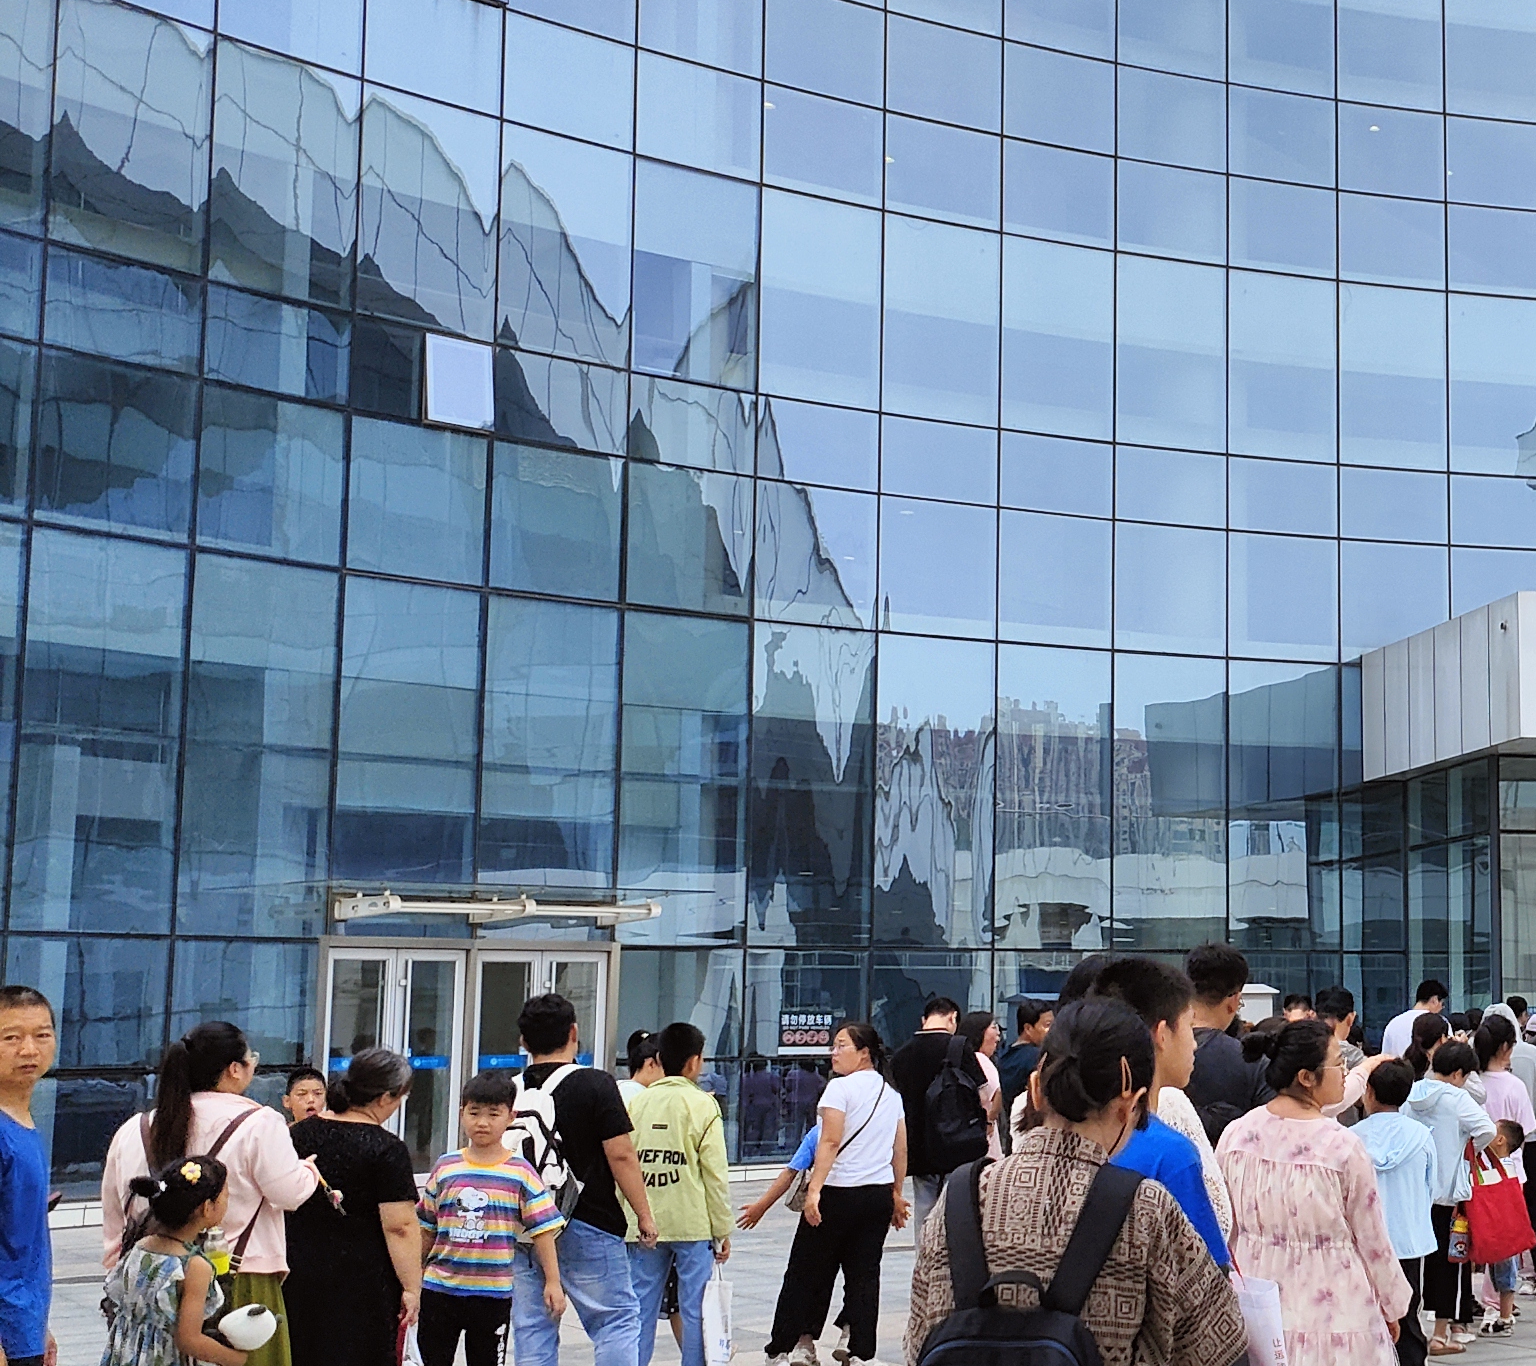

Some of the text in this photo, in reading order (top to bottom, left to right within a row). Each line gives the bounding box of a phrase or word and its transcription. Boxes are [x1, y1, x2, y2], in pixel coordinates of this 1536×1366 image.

[781, 1014, 832, 1025] 请勿停放车辆
